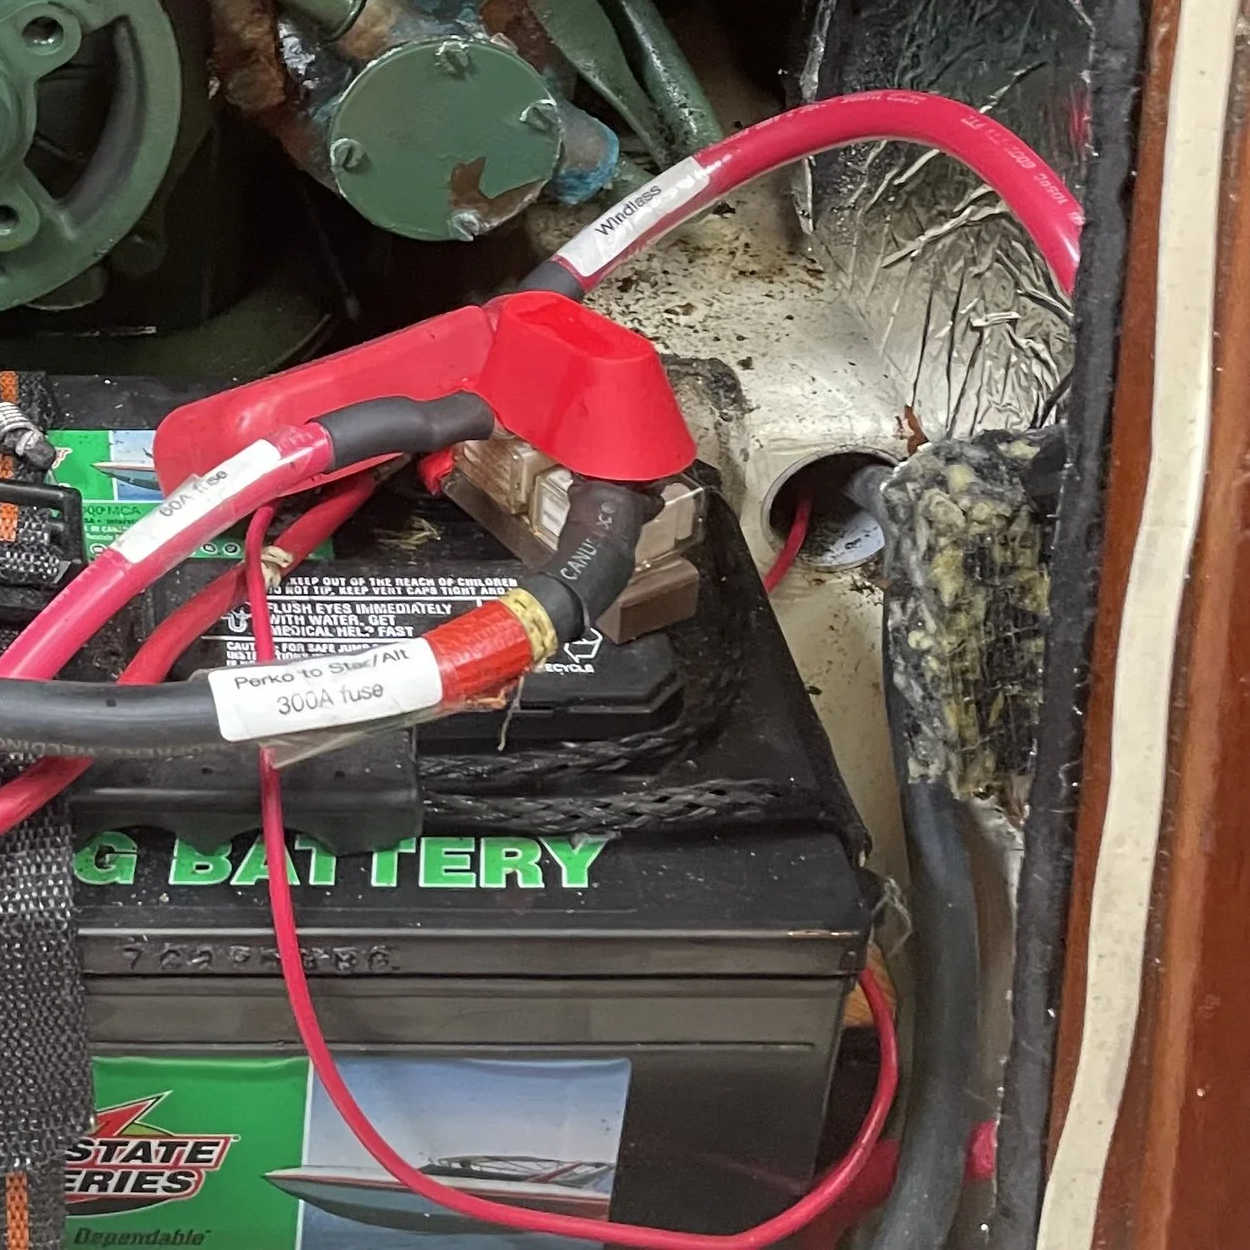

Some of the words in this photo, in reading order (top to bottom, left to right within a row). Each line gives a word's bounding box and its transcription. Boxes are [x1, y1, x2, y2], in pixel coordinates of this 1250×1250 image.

[594, 183, 662, 237] Windlass
[322, 577, 346, 586] OUT
[350, 578, 366, 586] OF
[395, 578, 436, 587] REACH
[440, 578, 454, 586] OF
[338, 586, 369, 595] KEEP
[373, 586, 403, 595] VENT
[407, 586, 438, 595] CAPS
[441, 586, 477, 595] TIGHT
[268, 602, 312, 614] FLUSH
[316, 602, 352, 614] EYES
[355, 603, 452, 615] IMMEDIATELY
[270, 614, 305, 625] WITH
[368, 614, 396, 626] GET
[271, 625, 333, 638] MEDICAL
[378, 626, 414, 637] FAST
[281, 643, 305, 652] FOR
[234, 673, 294, 690] Perko
[301, 667, 323, 680] to
[276, 688, 335, 716] 300A
[340, 682, 385, 702] fuse
[168, 835, 608, 889] BATTERY
[63, 1170, 196, 1195] ERIES
